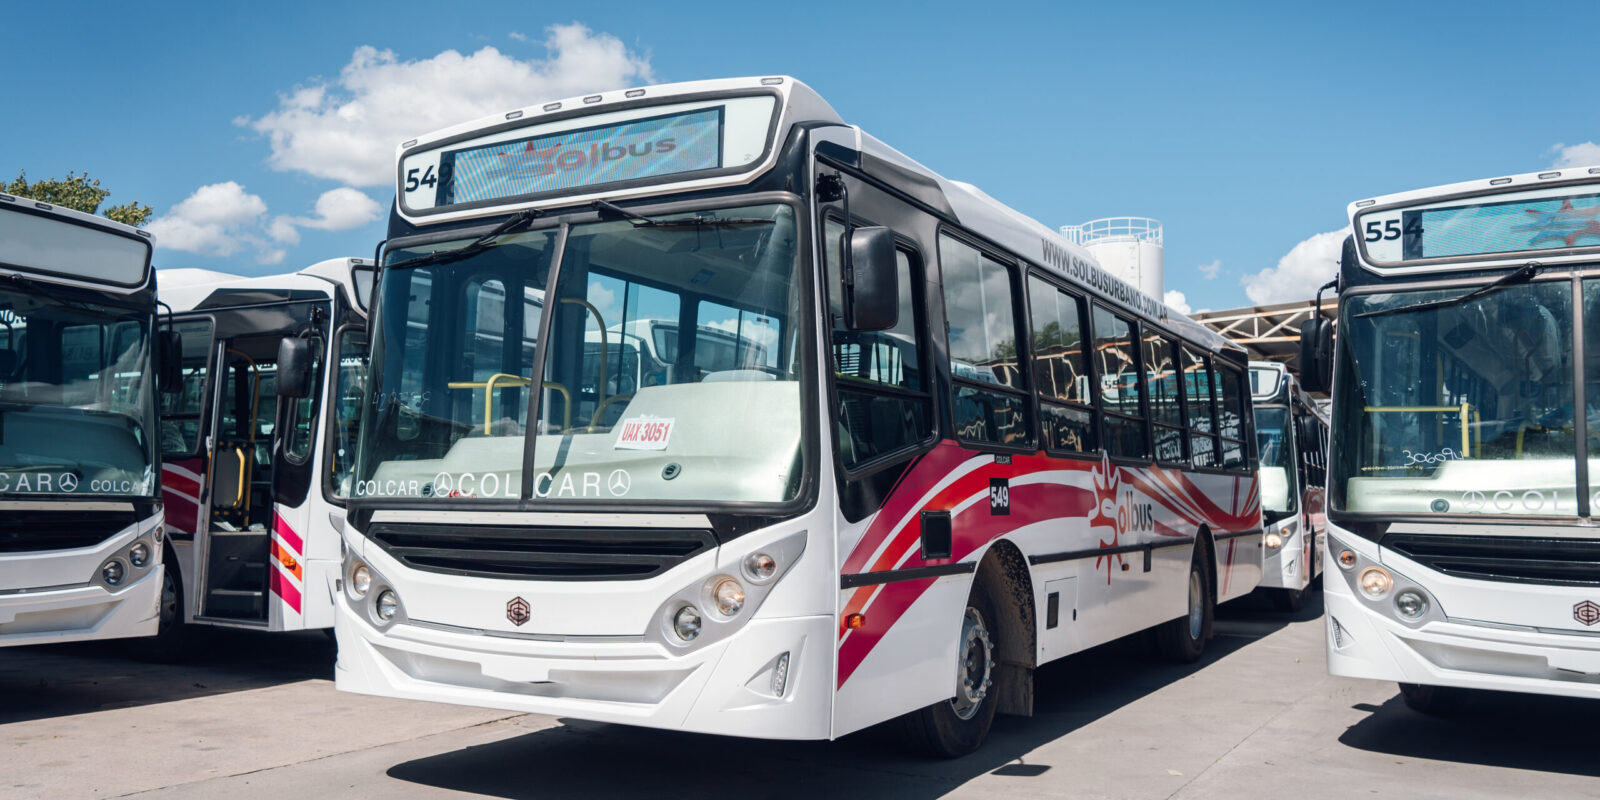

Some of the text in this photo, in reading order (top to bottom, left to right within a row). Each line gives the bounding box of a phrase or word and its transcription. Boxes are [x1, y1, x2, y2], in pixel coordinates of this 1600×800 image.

[1365, 217, 1425, 243] 554
[1402, 447, 1464, 466] 306094
[356, 480, 418, 496] COLCAR
[991, 486, 1009, 508] 549
